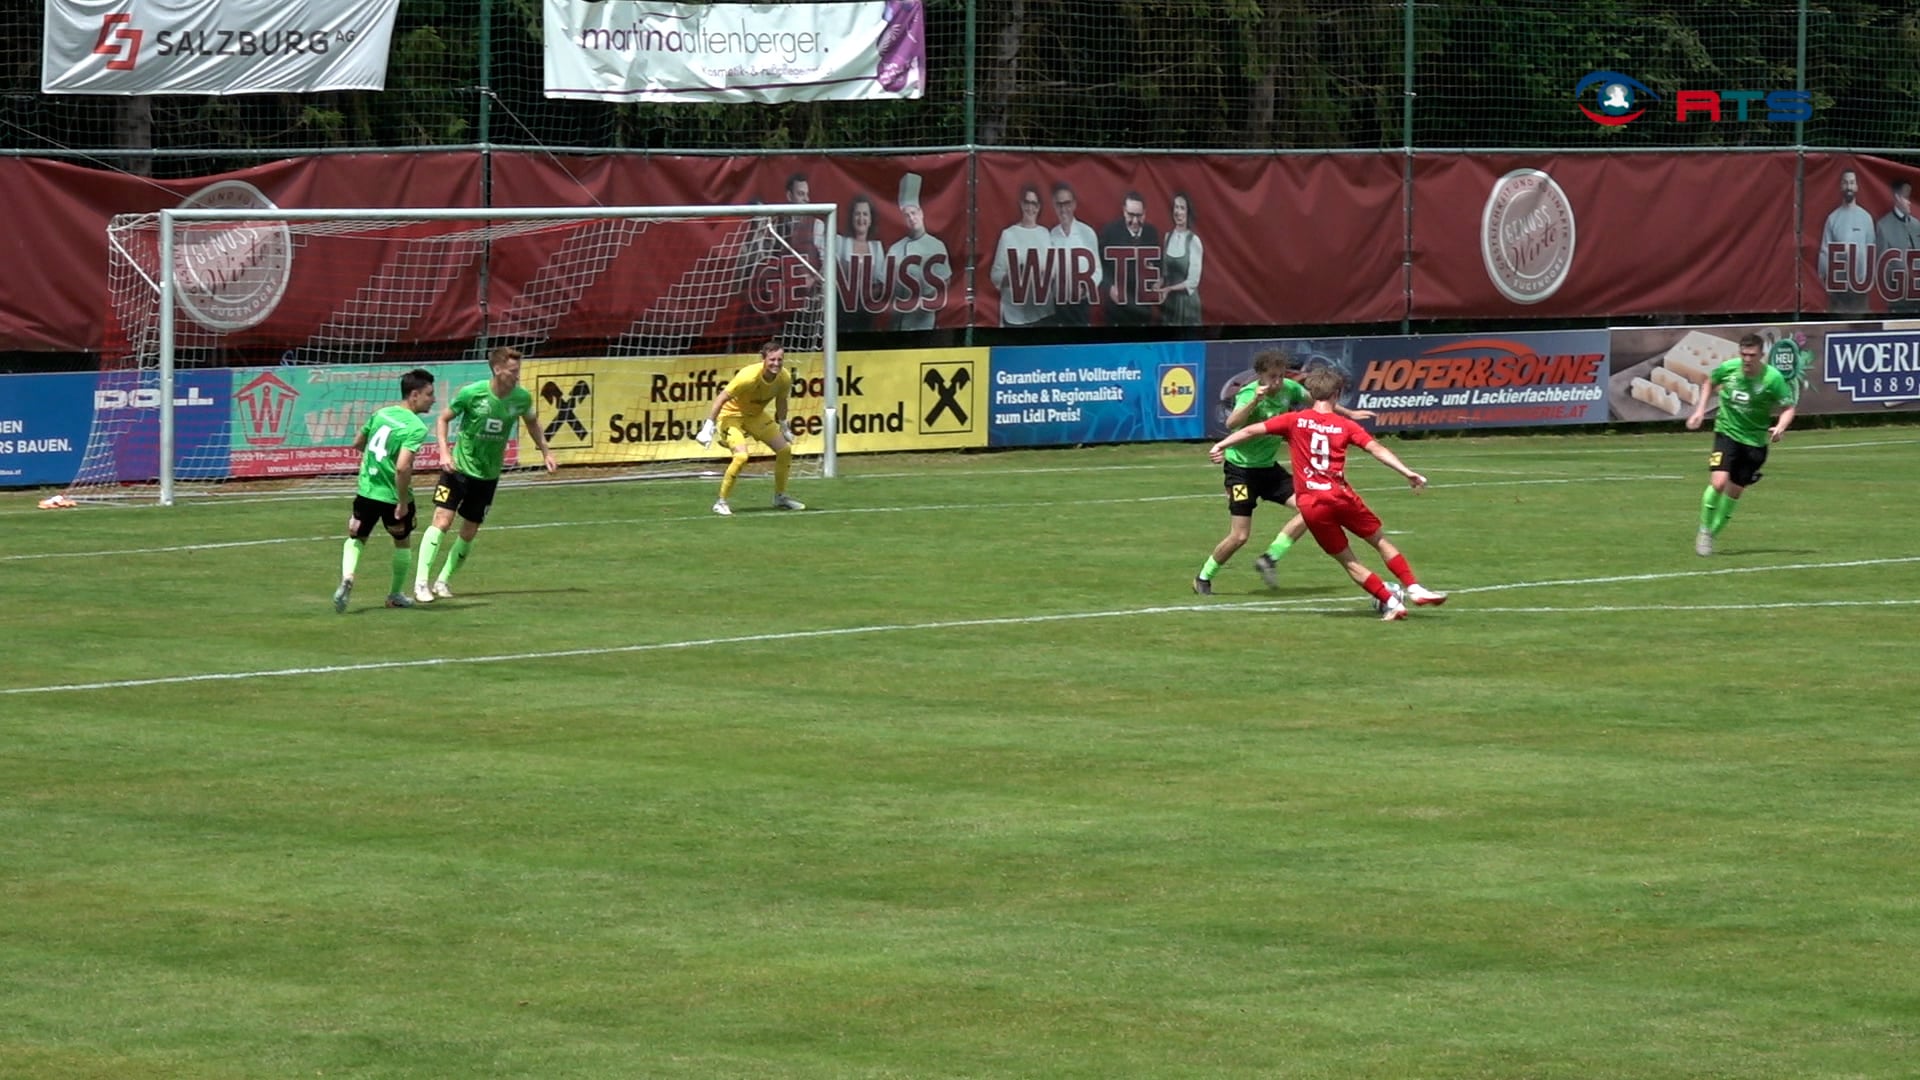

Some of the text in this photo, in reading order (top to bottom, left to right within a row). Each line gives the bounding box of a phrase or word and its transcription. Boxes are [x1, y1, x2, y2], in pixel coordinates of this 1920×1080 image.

[155, 29, 355, 57] SALZBURG AG
[750, 253, 947, 313] GENUSS
[1775, 353, 1794, 364] HEU
[651, 365, 864, 403] Raiffebank
[996, 366, 1141, 385] Garantiert ein Volltreffer:
[1860, 377, 1914, 394] 1889
[996, 386, 1123, 406] Frische & Regionalität
[1357, 386, 1603, 409] Karosserie- und Lackierfachbetrieb
[995, 408, 1081, 425] zum Lidl Preis!
[17, 438, 72, 454] BAUEN.
[368, 425, 392, 462] 4
[1310, 432, 1330, 471] 9
